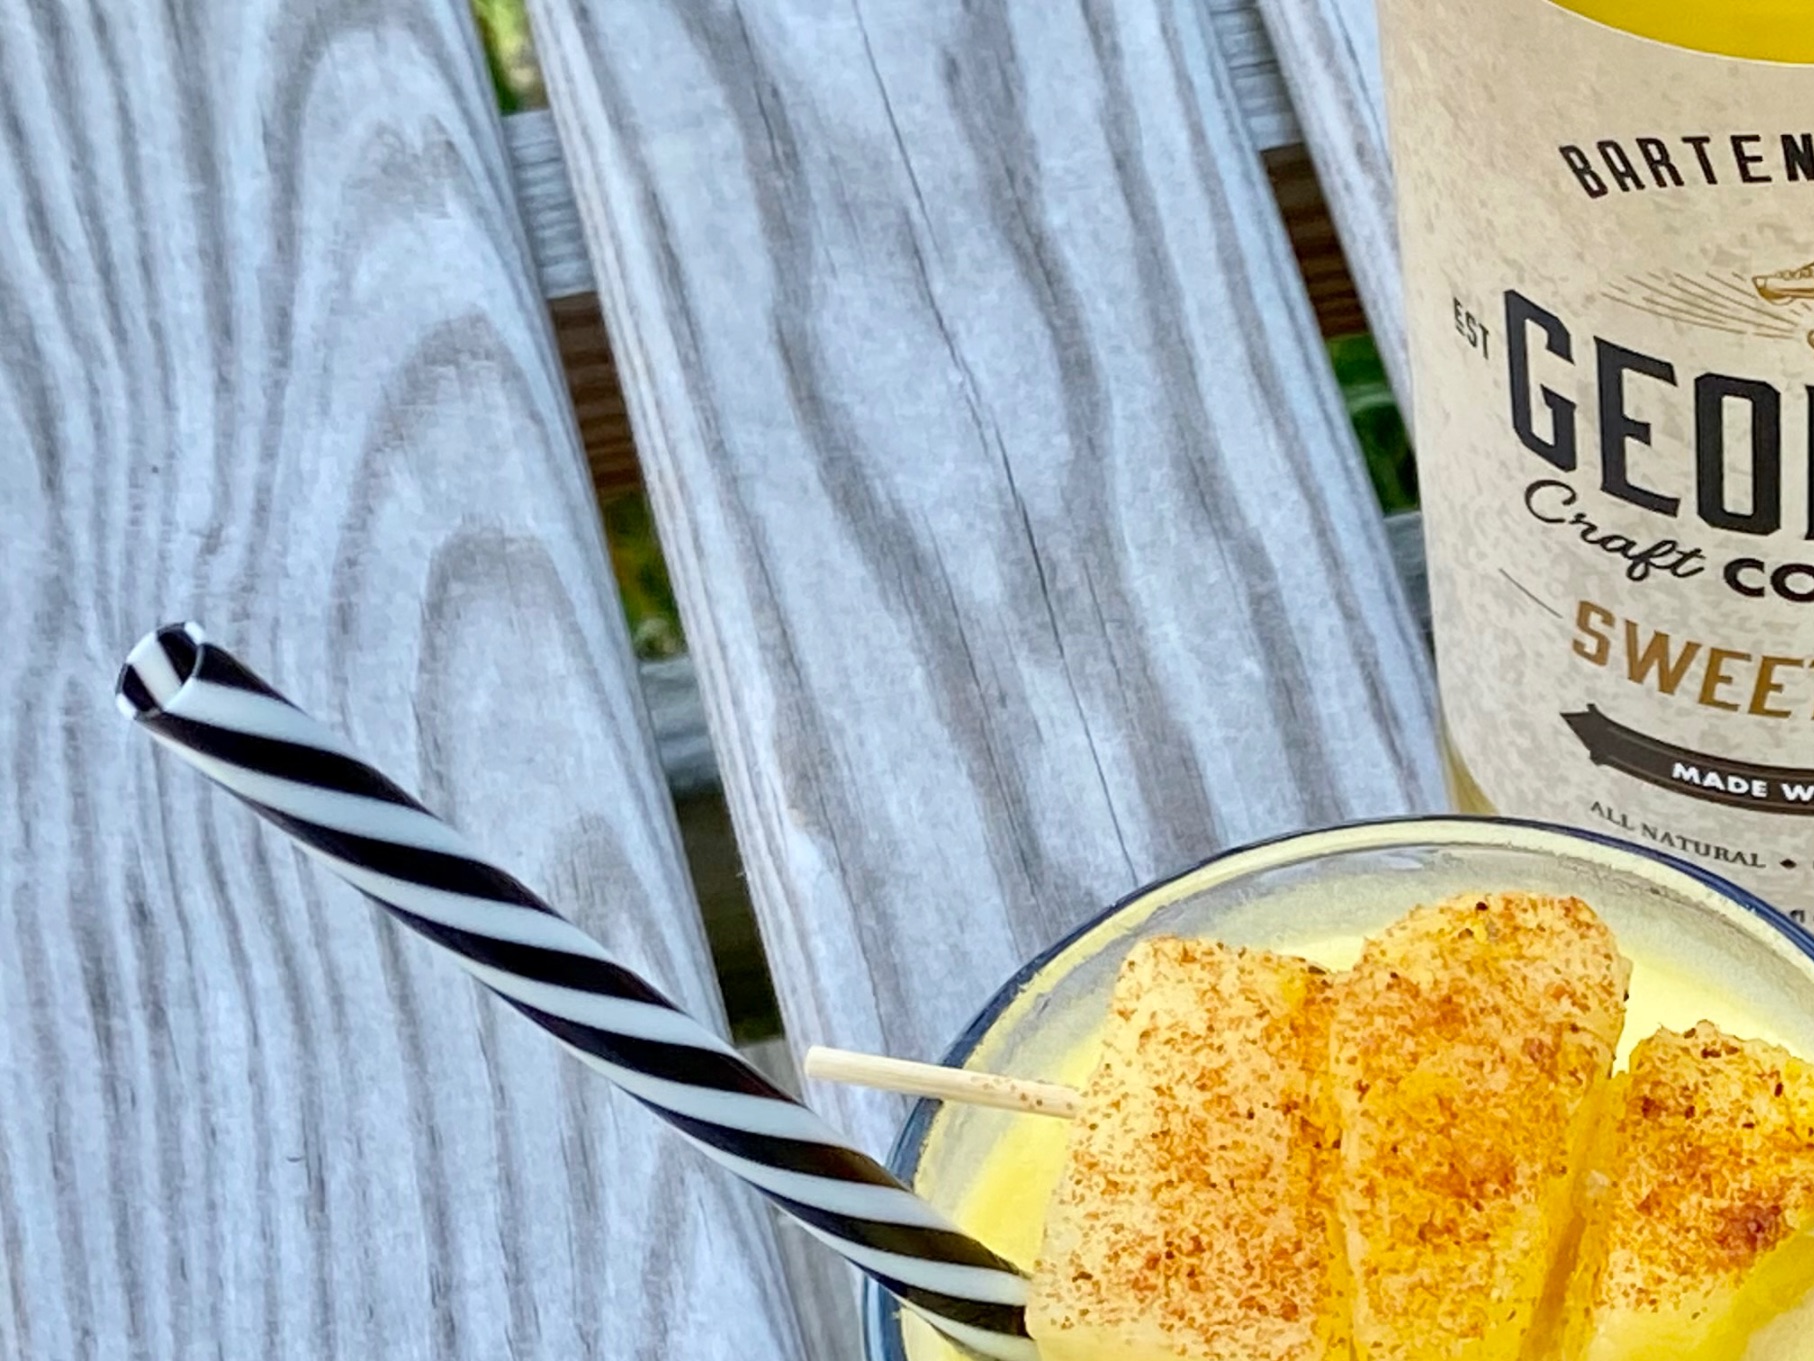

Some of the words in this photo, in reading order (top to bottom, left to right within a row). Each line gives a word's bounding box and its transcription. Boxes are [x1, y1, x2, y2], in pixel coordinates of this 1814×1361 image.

[1453, 296, 1490, 360] EST
[1524, 479, 1706, 582] Craft
[1671, 762, 1769, 799] MADE
[1589, 799, 1637, 832] ALL
[1640, 818, 1767, 869] NATURAL
